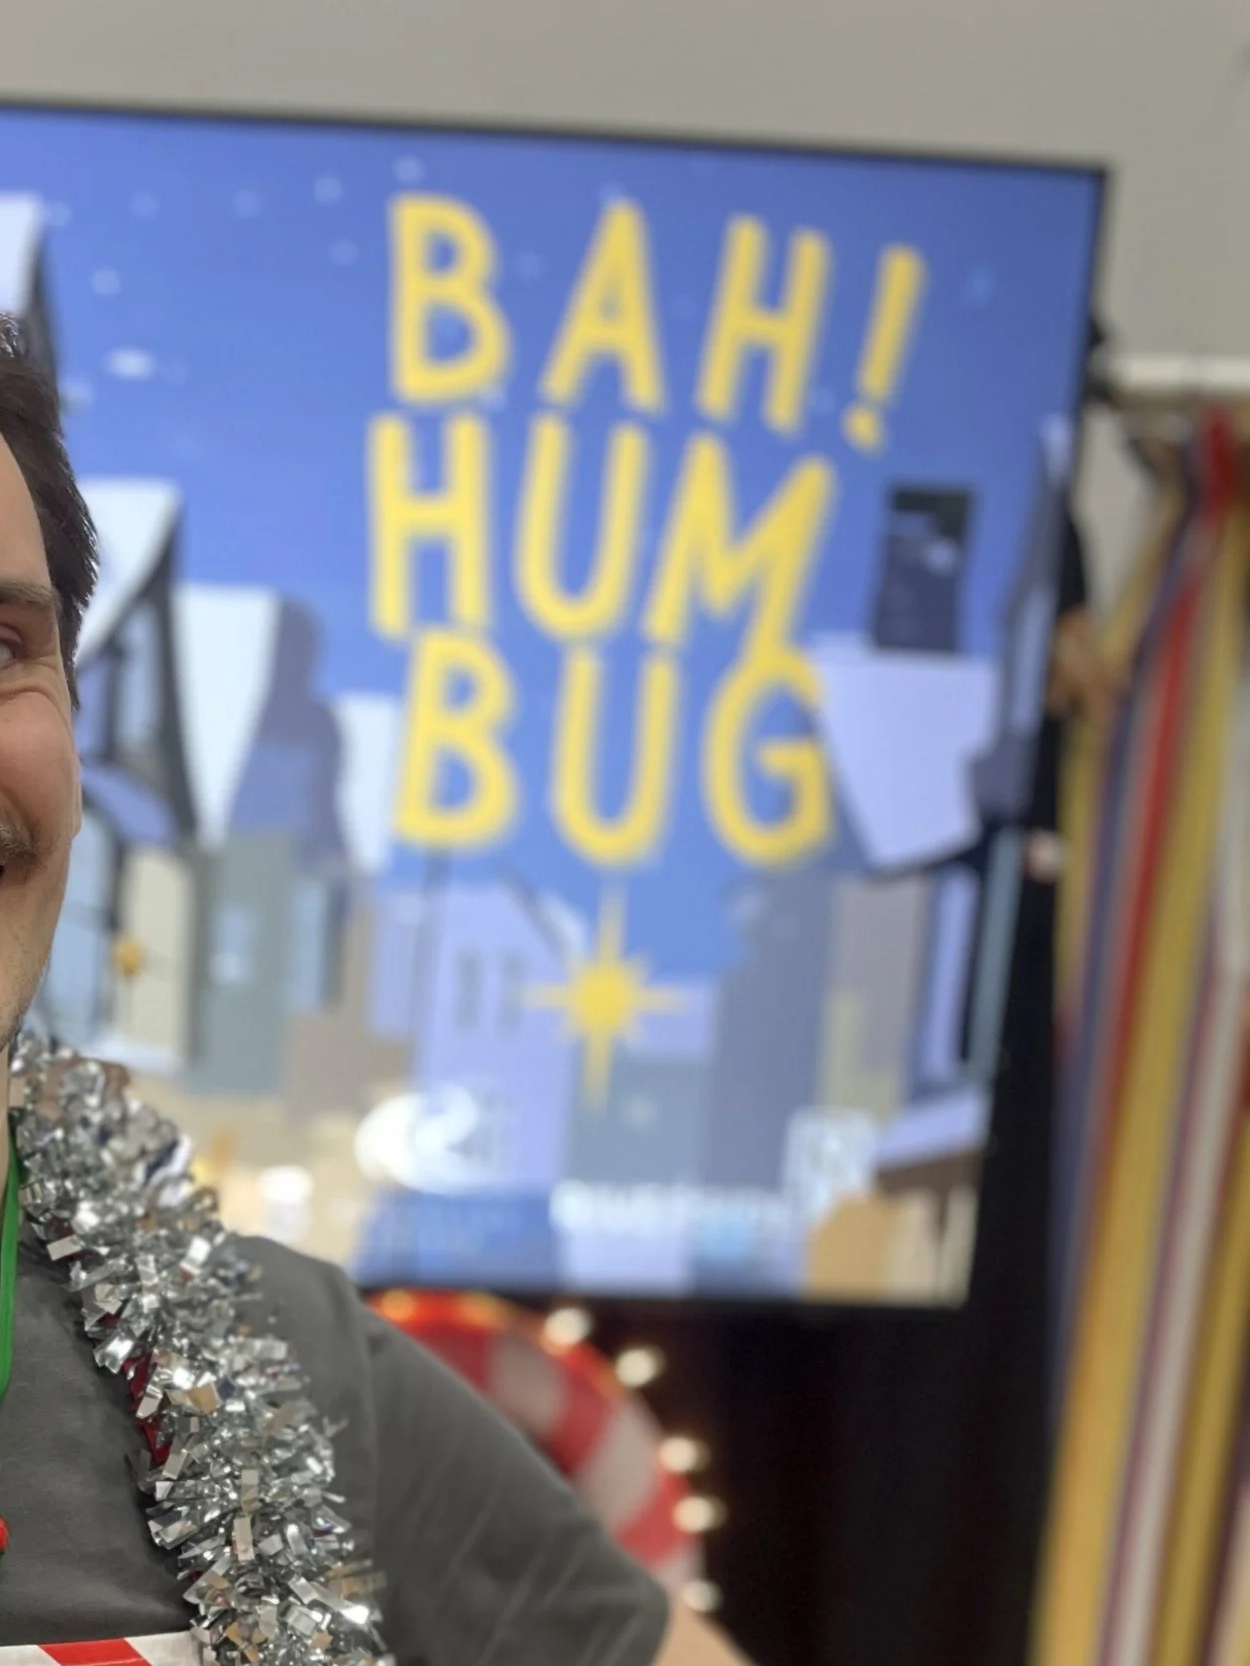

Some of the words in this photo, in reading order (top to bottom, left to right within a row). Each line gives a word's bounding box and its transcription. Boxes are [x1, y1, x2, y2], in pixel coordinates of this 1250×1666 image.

[392, 196, 921, 446] BAH!
[370, 414, 833, 650] HUM
[395, 632, 830, 868] BUG
